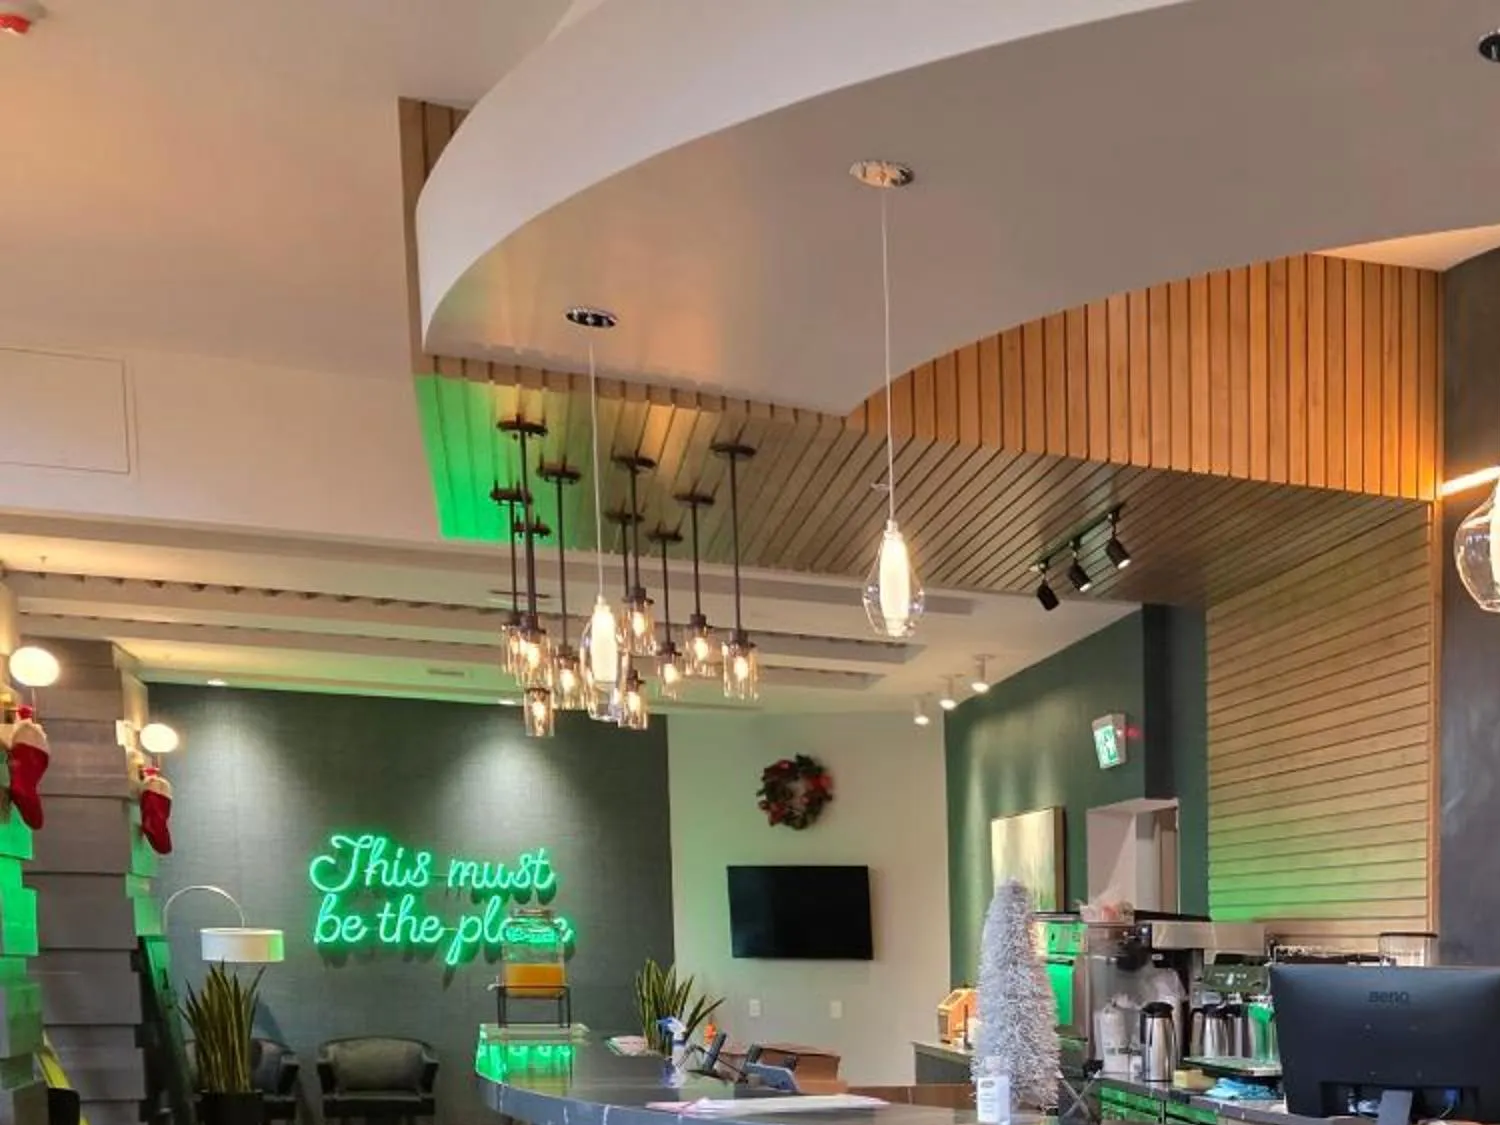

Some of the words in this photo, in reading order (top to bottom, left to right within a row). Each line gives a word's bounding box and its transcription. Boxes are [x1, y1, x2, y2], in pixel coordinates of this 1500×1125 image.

[309, 833, 431, 892] This
[447, 847, 556, 889] must
[313, 893, 370, 944] be
[376, 893, 447, 944] the
